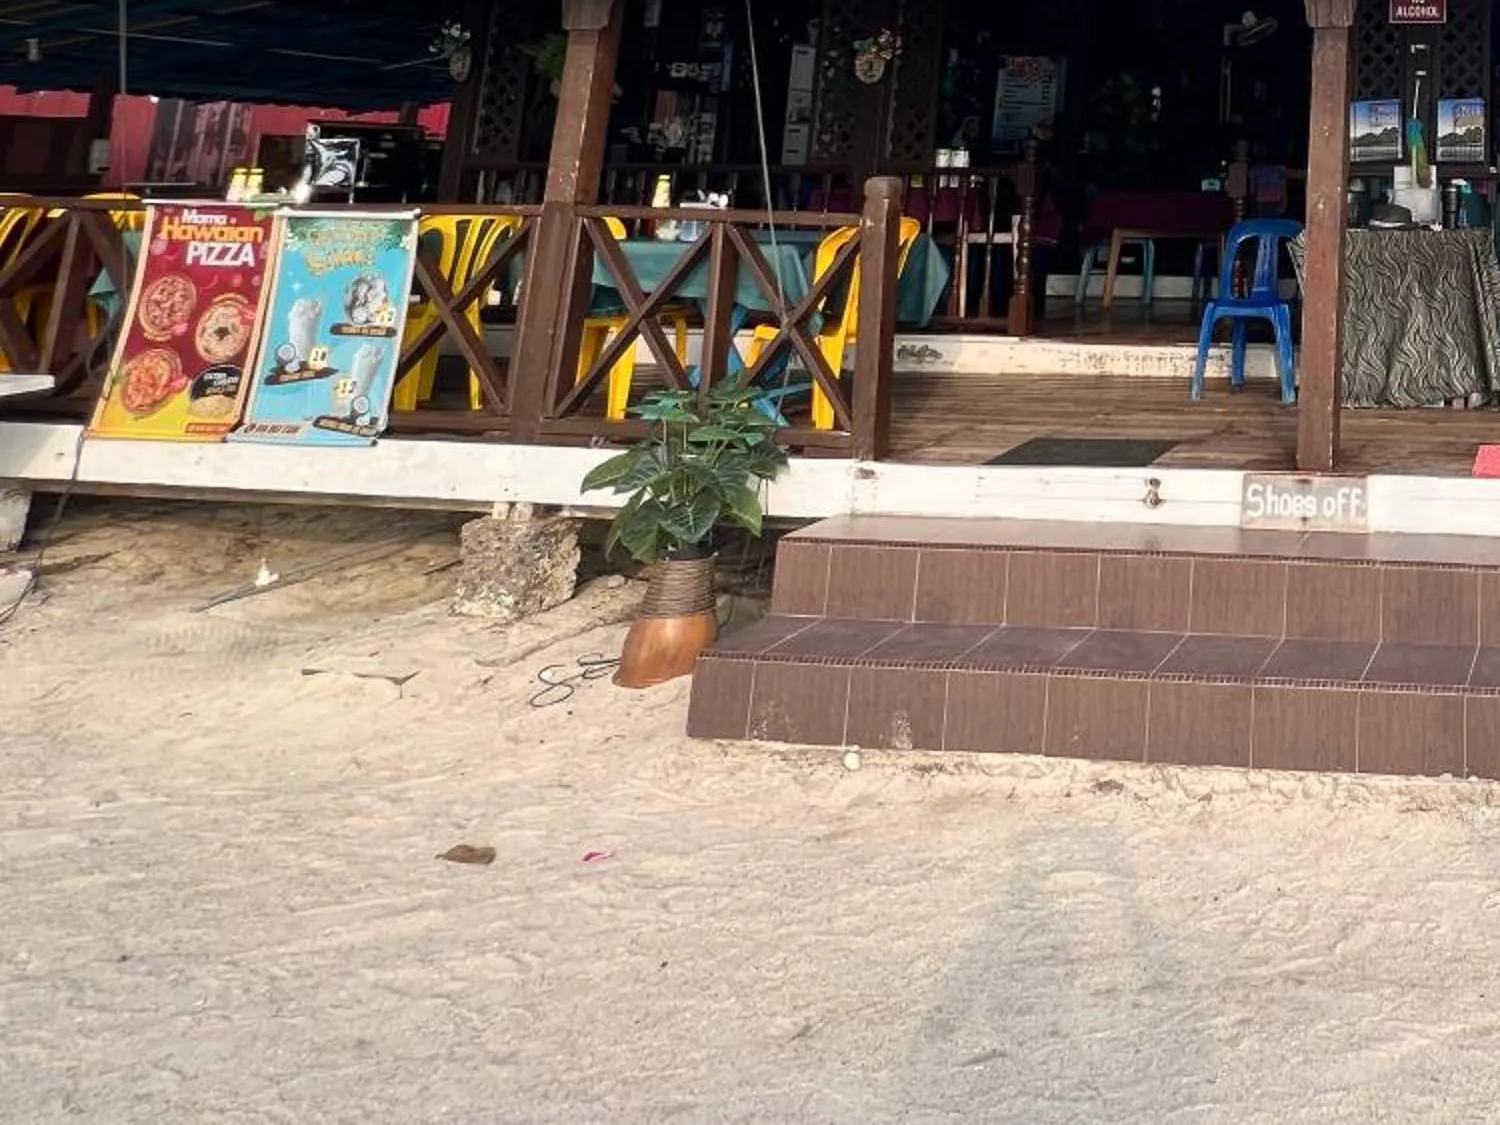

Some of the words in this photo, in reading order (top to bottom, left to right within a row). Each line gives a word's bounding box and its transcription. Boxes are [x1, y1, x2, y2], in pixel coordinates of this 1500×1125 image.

[1395, 6, 1440, 18] ALCOHOL
[182, 208, 227, 225] Mama
[185, 241, 255, 267] PIZZA
[1247, 483, 1317, 517] Shoes
[1323, 487, 1363, 518] off
